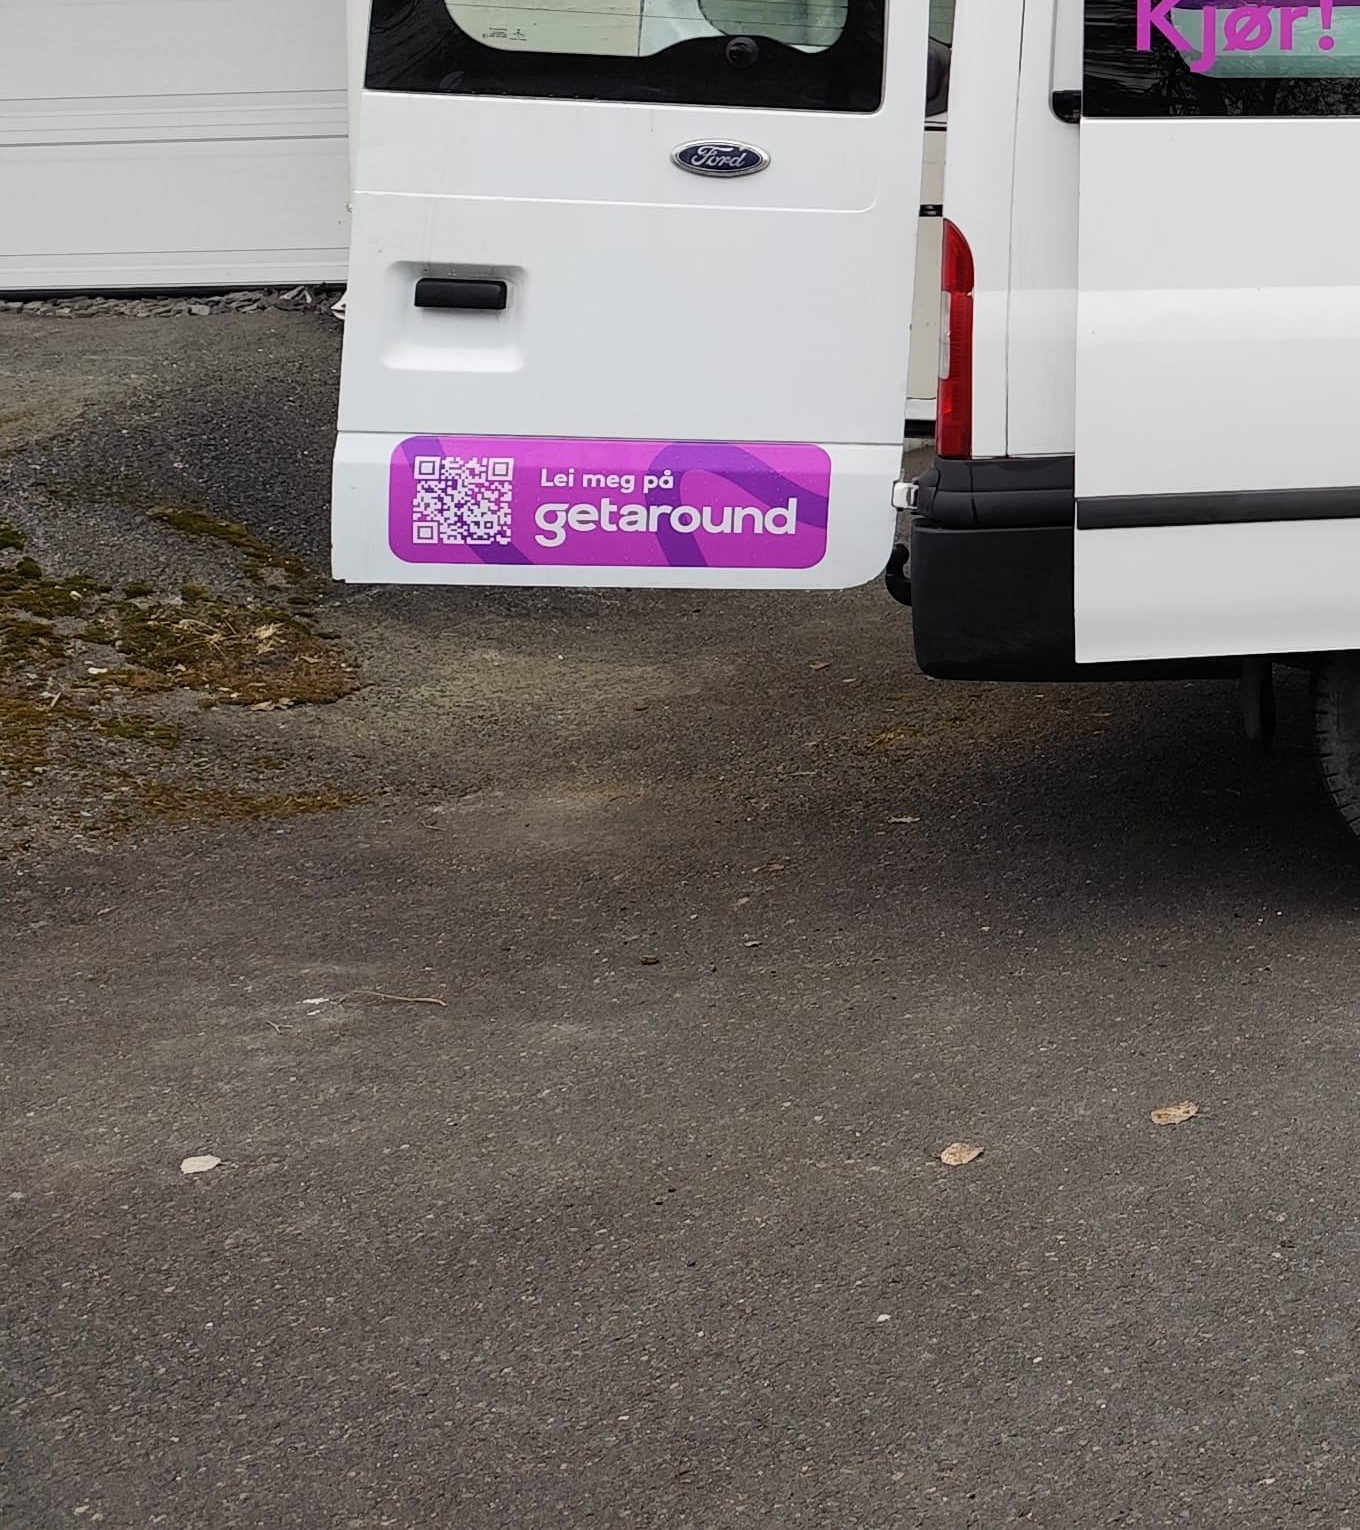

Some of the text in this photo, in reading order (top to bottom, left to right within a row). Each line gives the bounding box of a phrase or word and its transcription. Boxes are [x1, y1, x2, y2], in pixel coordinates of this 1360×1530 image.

[690, 145, 748, 168] Ford
[540, 467, 675, 495] Lei meg på
[534, 497, 798, 548] getaround
